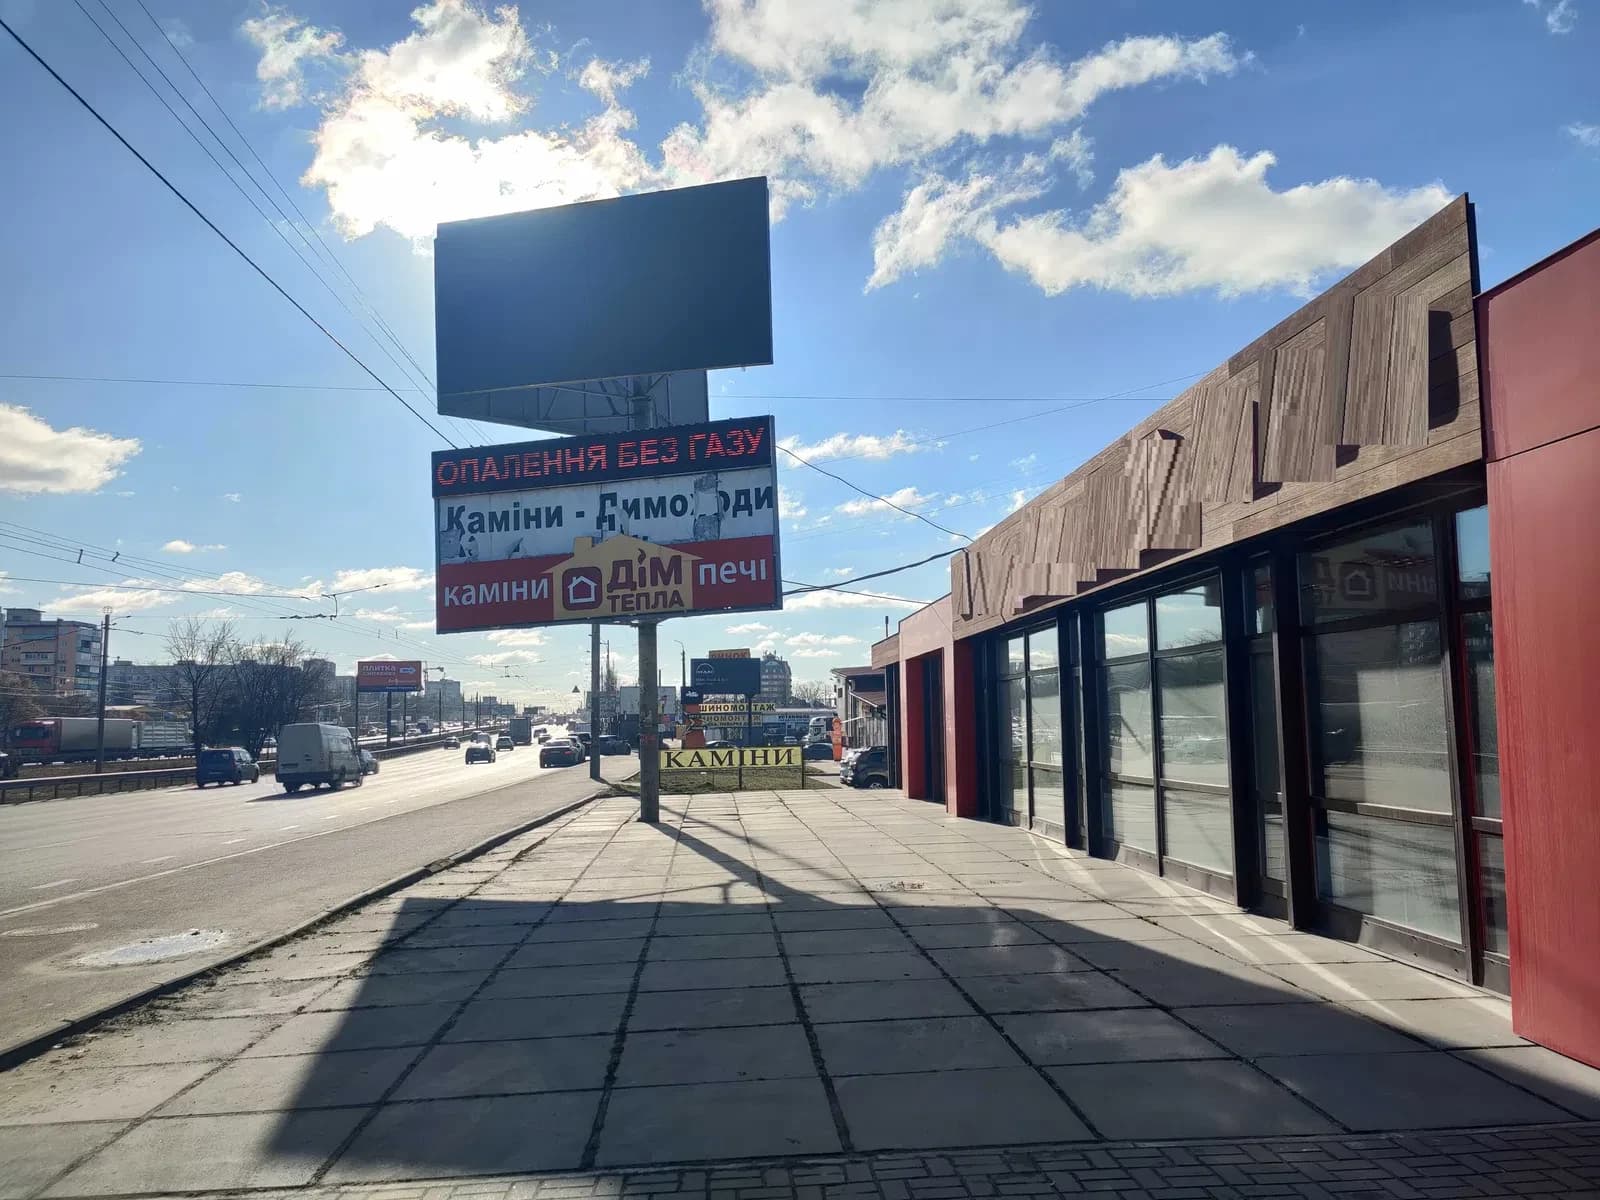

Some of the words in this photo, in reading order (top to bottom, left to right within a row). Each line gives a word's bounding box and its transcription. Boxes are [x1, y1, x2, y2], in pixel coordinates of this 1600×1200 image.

[435, 444, 607, 486] ОПАЛЕННЯ
[617, 437, 679, 468] БЕЗ
[687, 427, 765, 460] ГАЗУ
[446, 501, 563, 535] Каміни
[699, 559, 768, 585] печі
[443, 578, 549, 608] каміни
[606, 590, 685, 613] ТЕПЛА
[699, 703, 776, 713] ШИНОМОТАЖ
[664, 748, 796, 768] КАМІНИ
